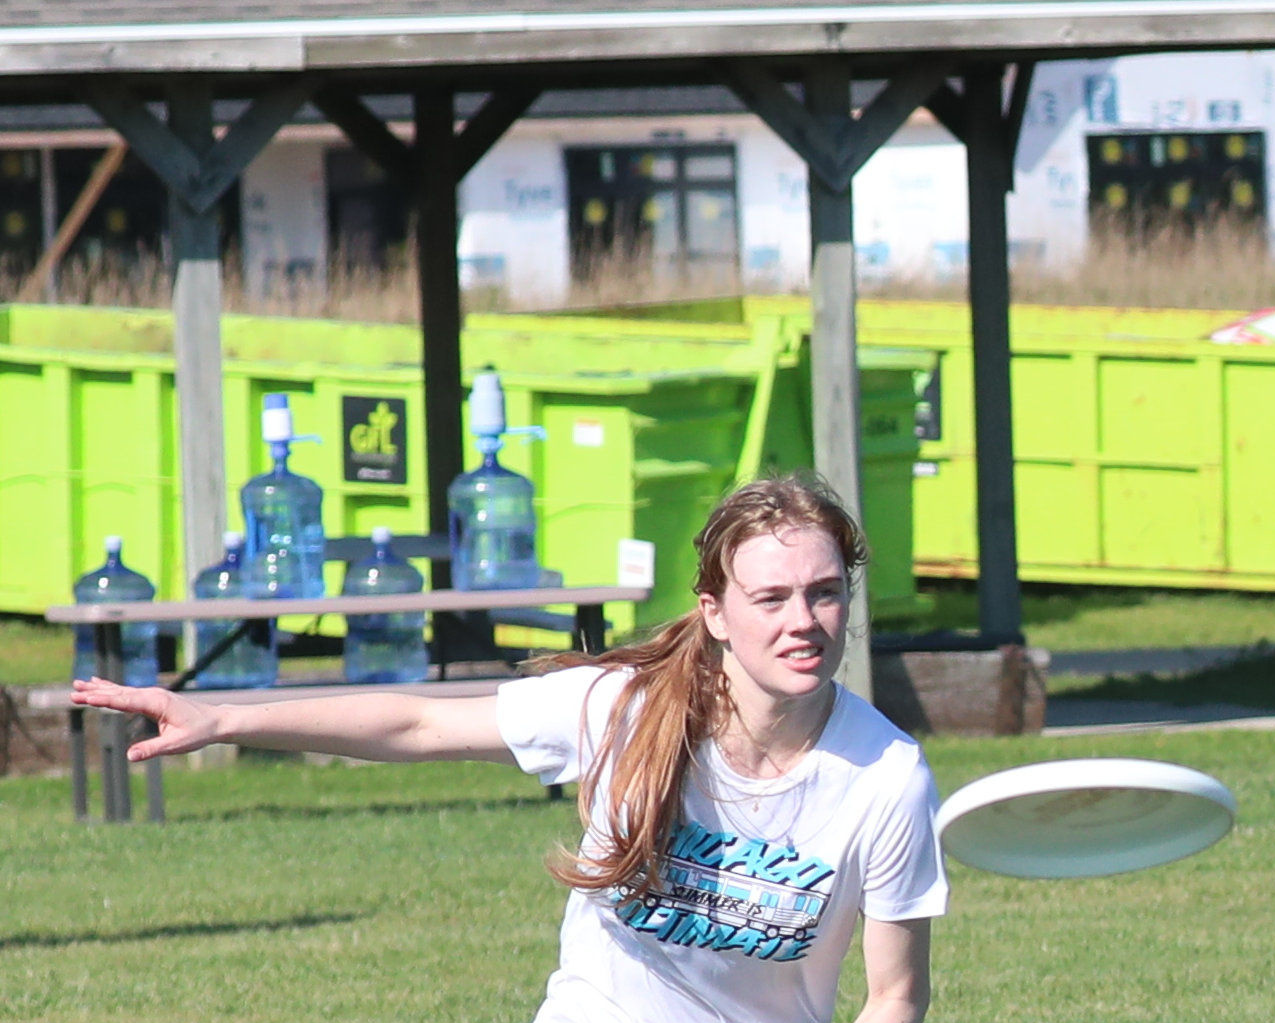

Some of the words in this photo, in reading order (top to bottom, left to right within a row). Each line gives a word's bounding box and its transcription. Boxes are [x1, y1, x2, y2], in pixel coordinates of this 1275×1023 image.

[669, 819, 836, 891] HICAGO
[607, 890, 816, 963] ULTIMATE
[671, 884, 745, 912] SUMMER
